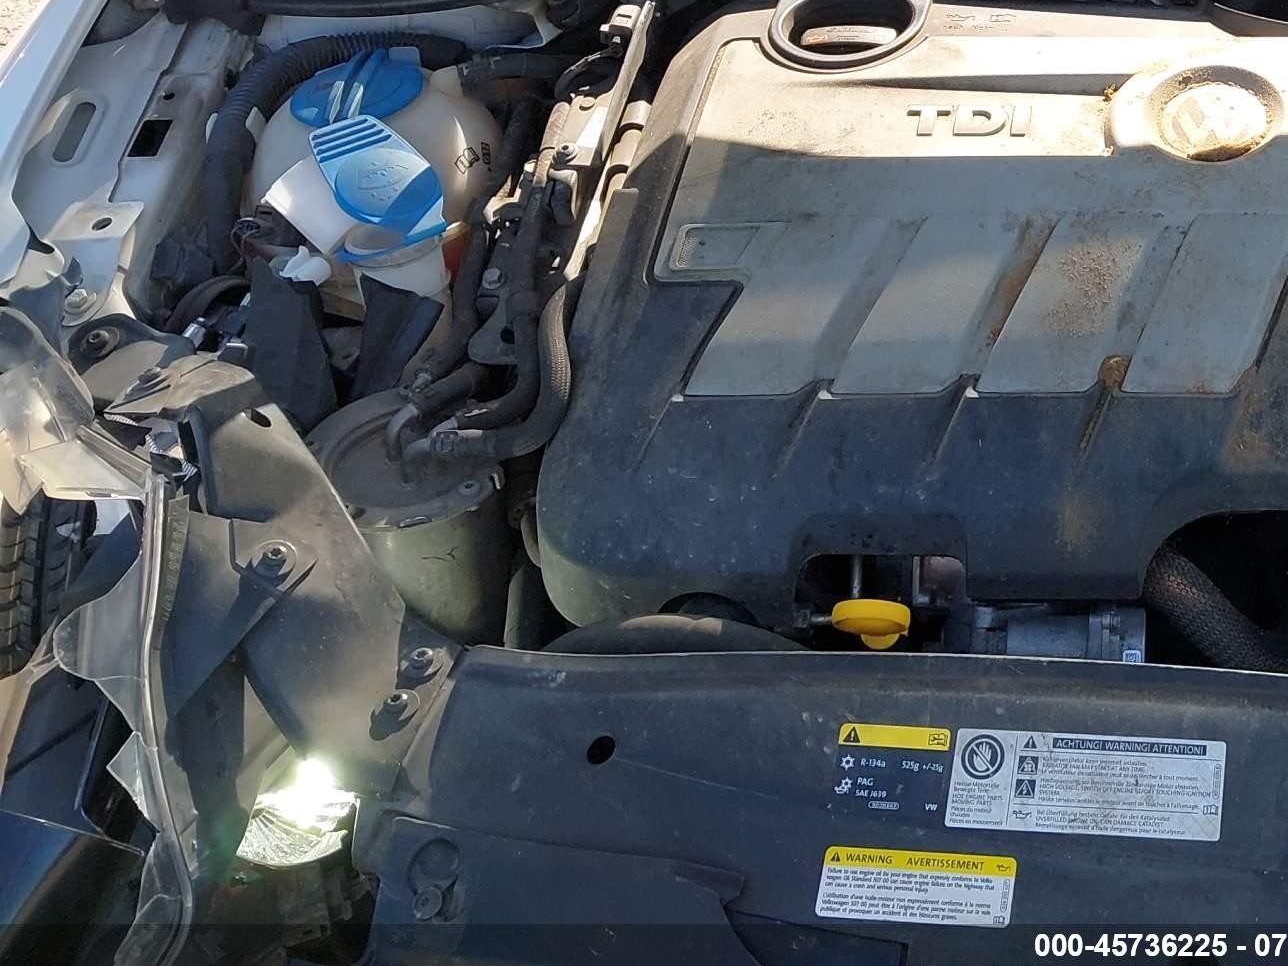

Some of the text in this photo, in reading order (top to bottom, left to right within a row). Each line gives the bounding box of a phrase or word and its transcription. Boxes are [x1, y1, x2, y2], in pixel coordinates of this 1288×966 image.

[906, 104, 1032, 138] TDI
[1055, 739, 1204, 754] ACHTUNG! WARNING! ATTENTION!
[860, 758, 886, 768] R-134a
[901, 760, 920, 772] 525g
[857, 777, 874, 786] PAG
[870, 790, 886, 798] J639
[924, 803, 938, 811] VW
[846, 852, 984, 871] WARNING AVERTISSEMENT
